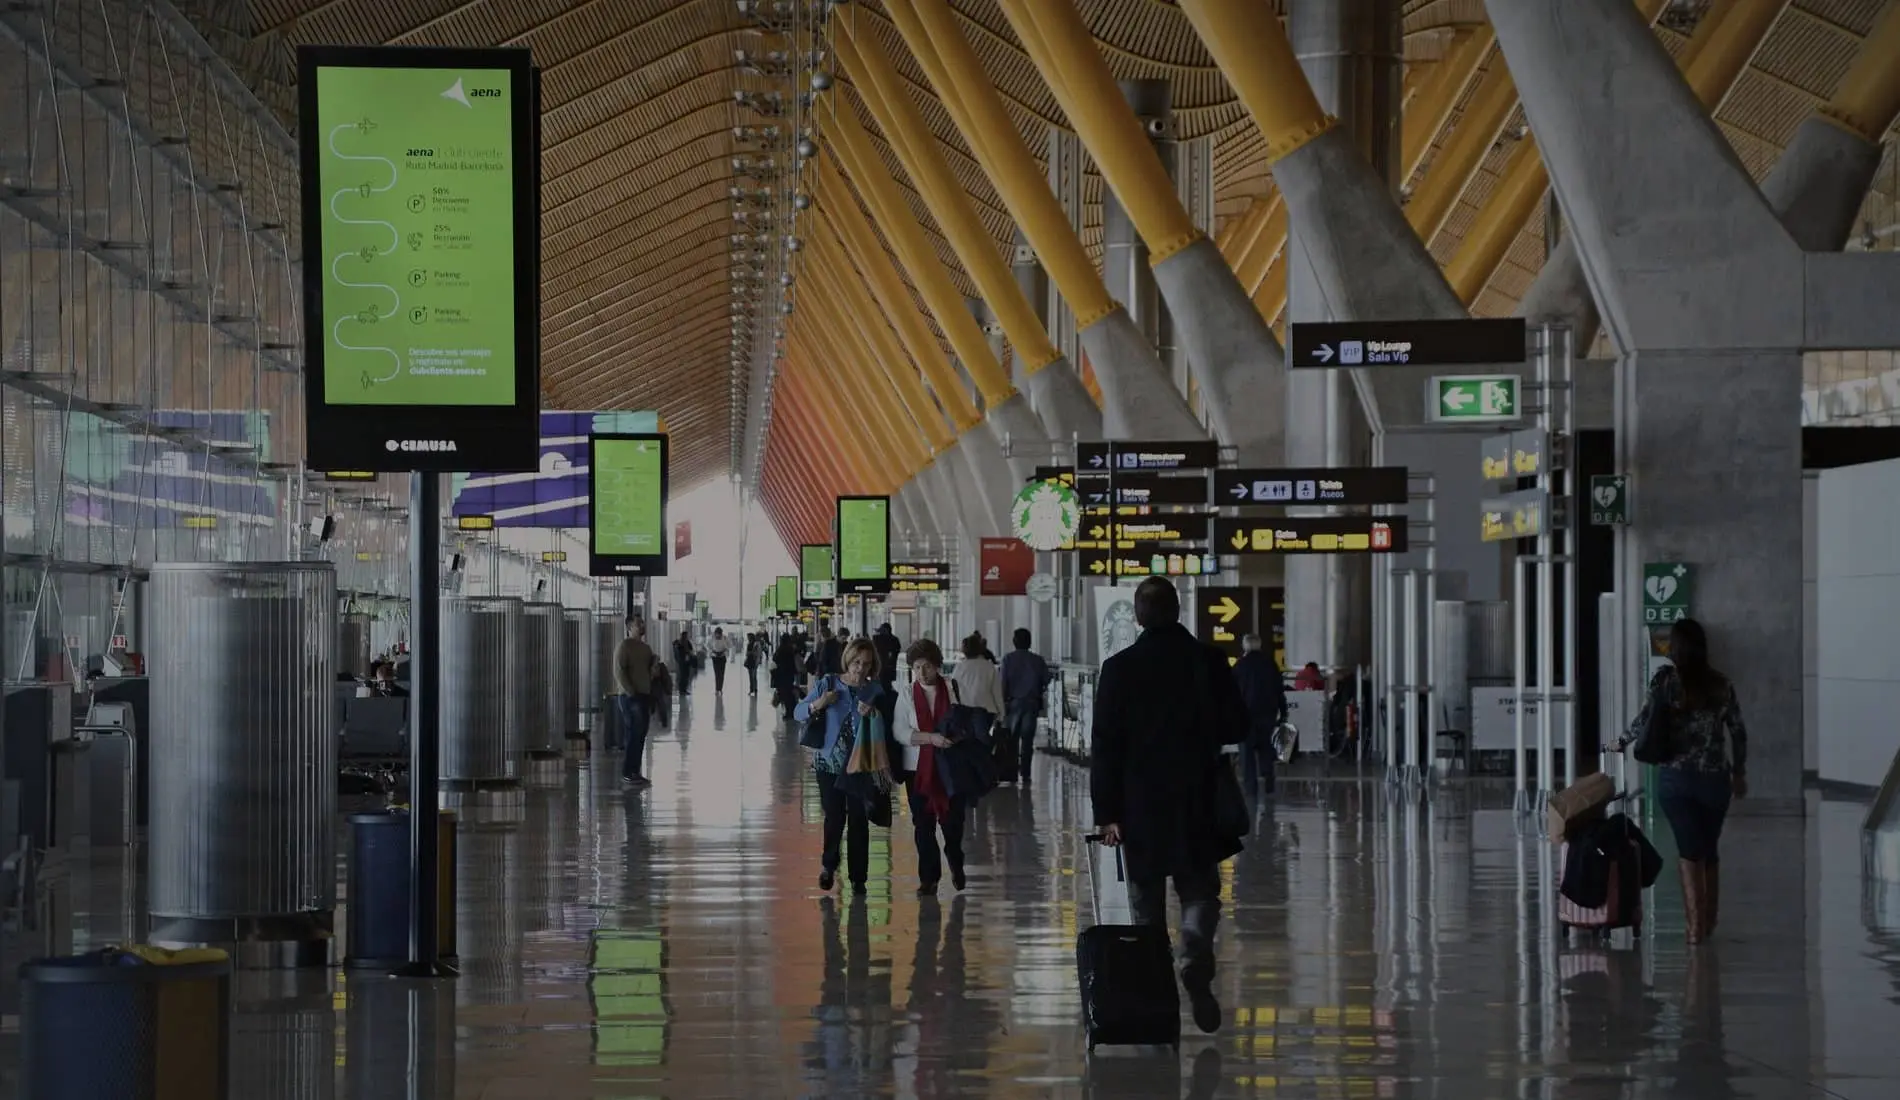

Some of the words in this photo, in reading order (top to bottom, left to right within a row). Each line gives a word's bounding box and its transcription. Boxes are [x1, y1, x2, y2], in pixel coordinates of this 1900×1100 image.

[470, 88, 501, 97] aena
[406, 148, 433, 157] aena
[1368, 351, 1390, 362] Sala
[1392, 351, 1409, 363] Vip
[400, 439, 457, 452] CEMUSA
[1320, 490, 1345, 499] Aseos
[1593, 511, 1624, 523] DEA
[1375, 531, 1387, 545] H
[1645, 607, 1686, 621] DEA
